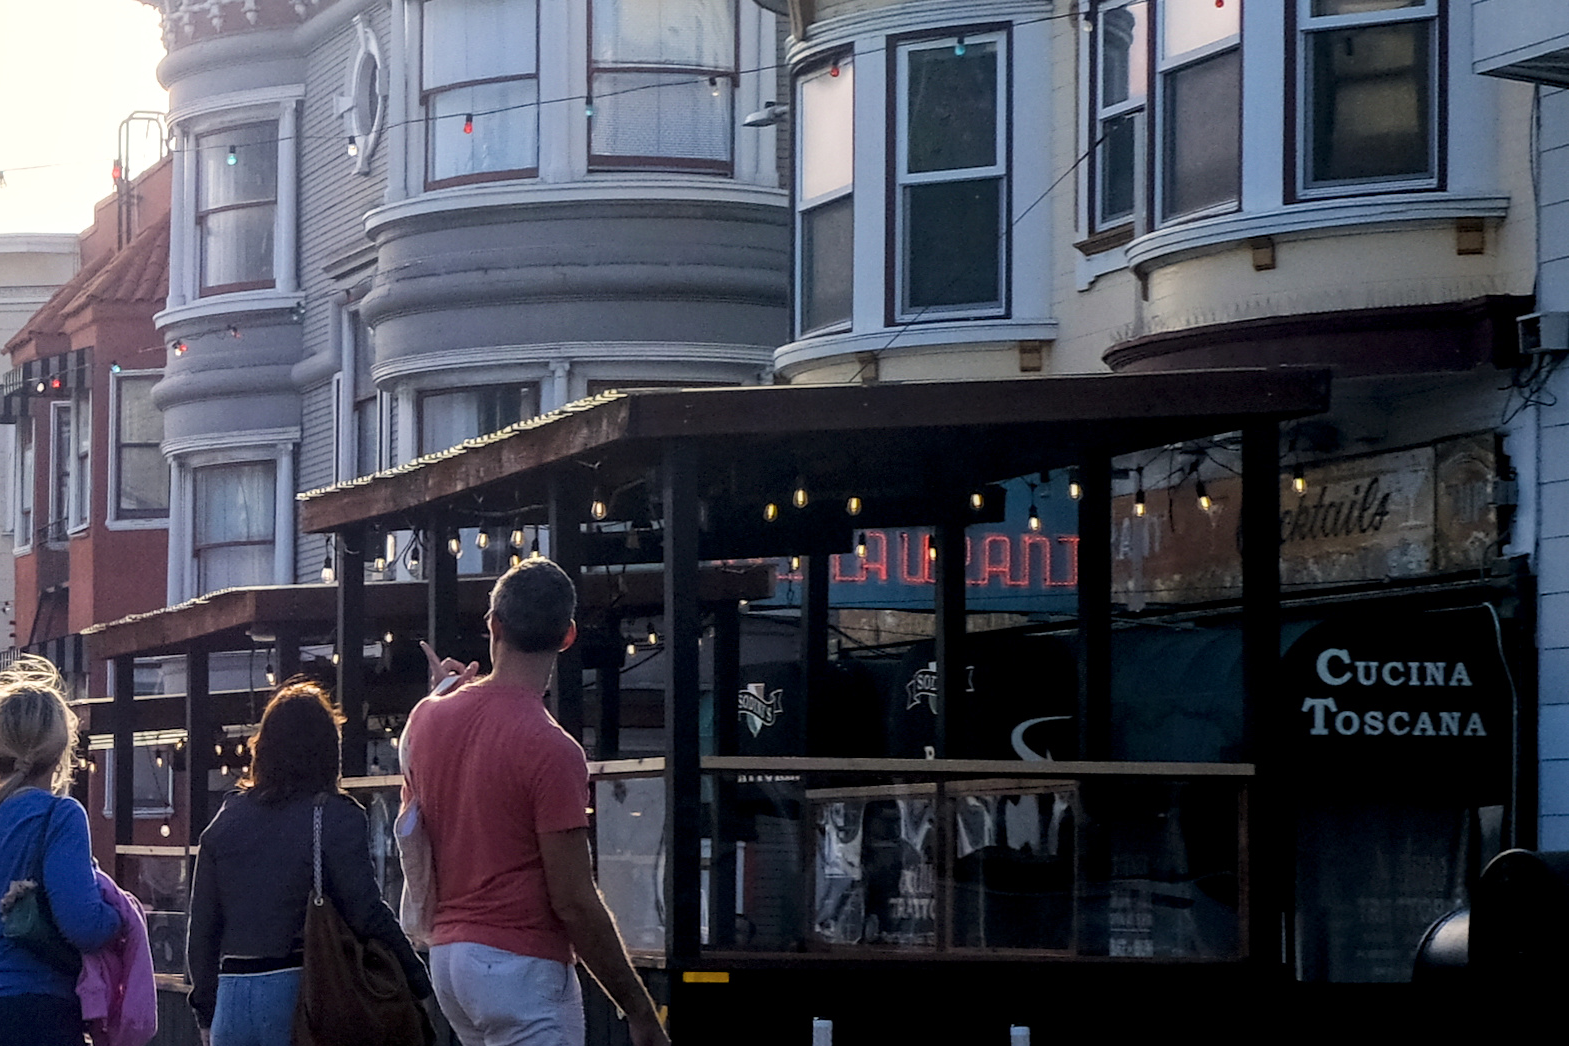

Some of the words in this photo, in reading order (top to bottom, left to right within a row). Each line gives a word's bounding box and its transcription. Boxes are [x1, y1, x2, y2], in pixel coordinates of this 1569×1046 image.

[1280, 477, 1392, 544] cktails
[1315, 648, 1474, 686] CUCINA
[1301, 697, 1488, 736] TOSCANA
